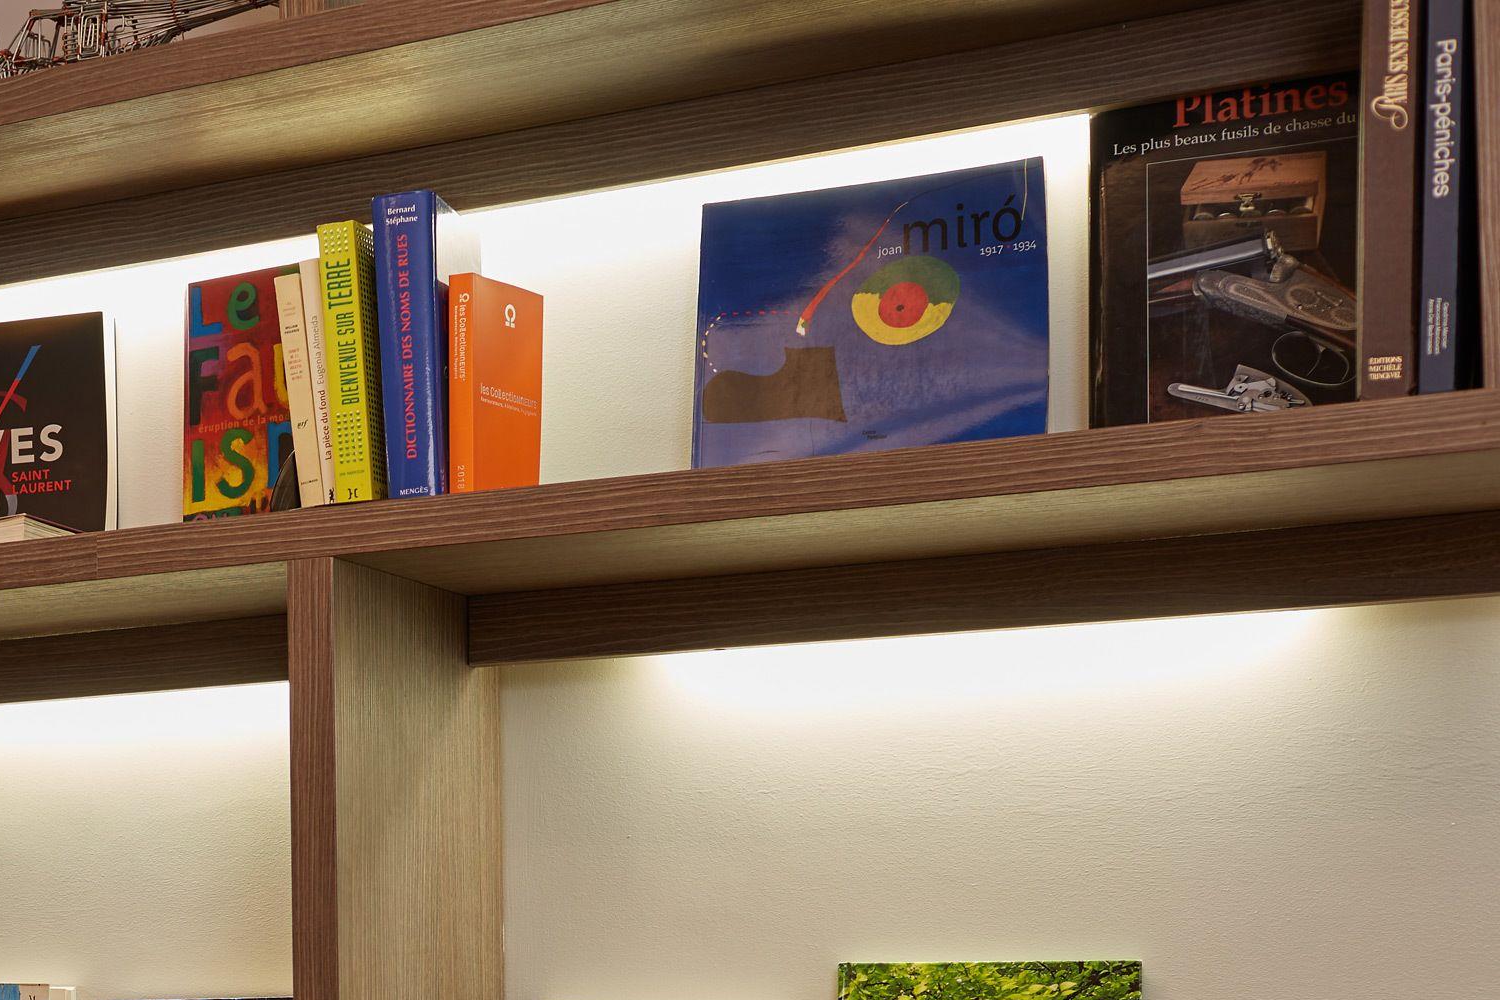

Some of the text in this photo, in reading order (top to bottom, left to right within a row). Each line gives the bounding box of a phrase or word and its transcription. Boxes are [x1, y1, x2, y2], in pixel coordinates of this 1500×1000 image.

[1388, 41, 1409, 74] SENS
[1173, 82, 1348, 128] Platines
[1430, 38, 1458, 199] Paris-péniches
[1113, 112, 1356, 156] Les plus beaux fusils de chasse du
[386, 215, 418, 226] Stéphane
[388, 204, 416, 216] Bernard
[903, 194, 1022, 253] miró
[877, 244, 902, 259] joan
[980, 240, 1037, 256] 1917 1934
[190, 281, 260, 337] Le
[326, 258, 360, 406] BIENVENUE SUR TERRE
[397, 234, 418, 460] DICTIONNAIRE DES NOMS DE RUES
[312, 316, 332, 460] La pièce du fond Eugenia Almeida
[12, 468, 50, 482] SAINT
[12, 480, 72, 495] LAURENT
[400, 486, 429, 496] MENGÈS
